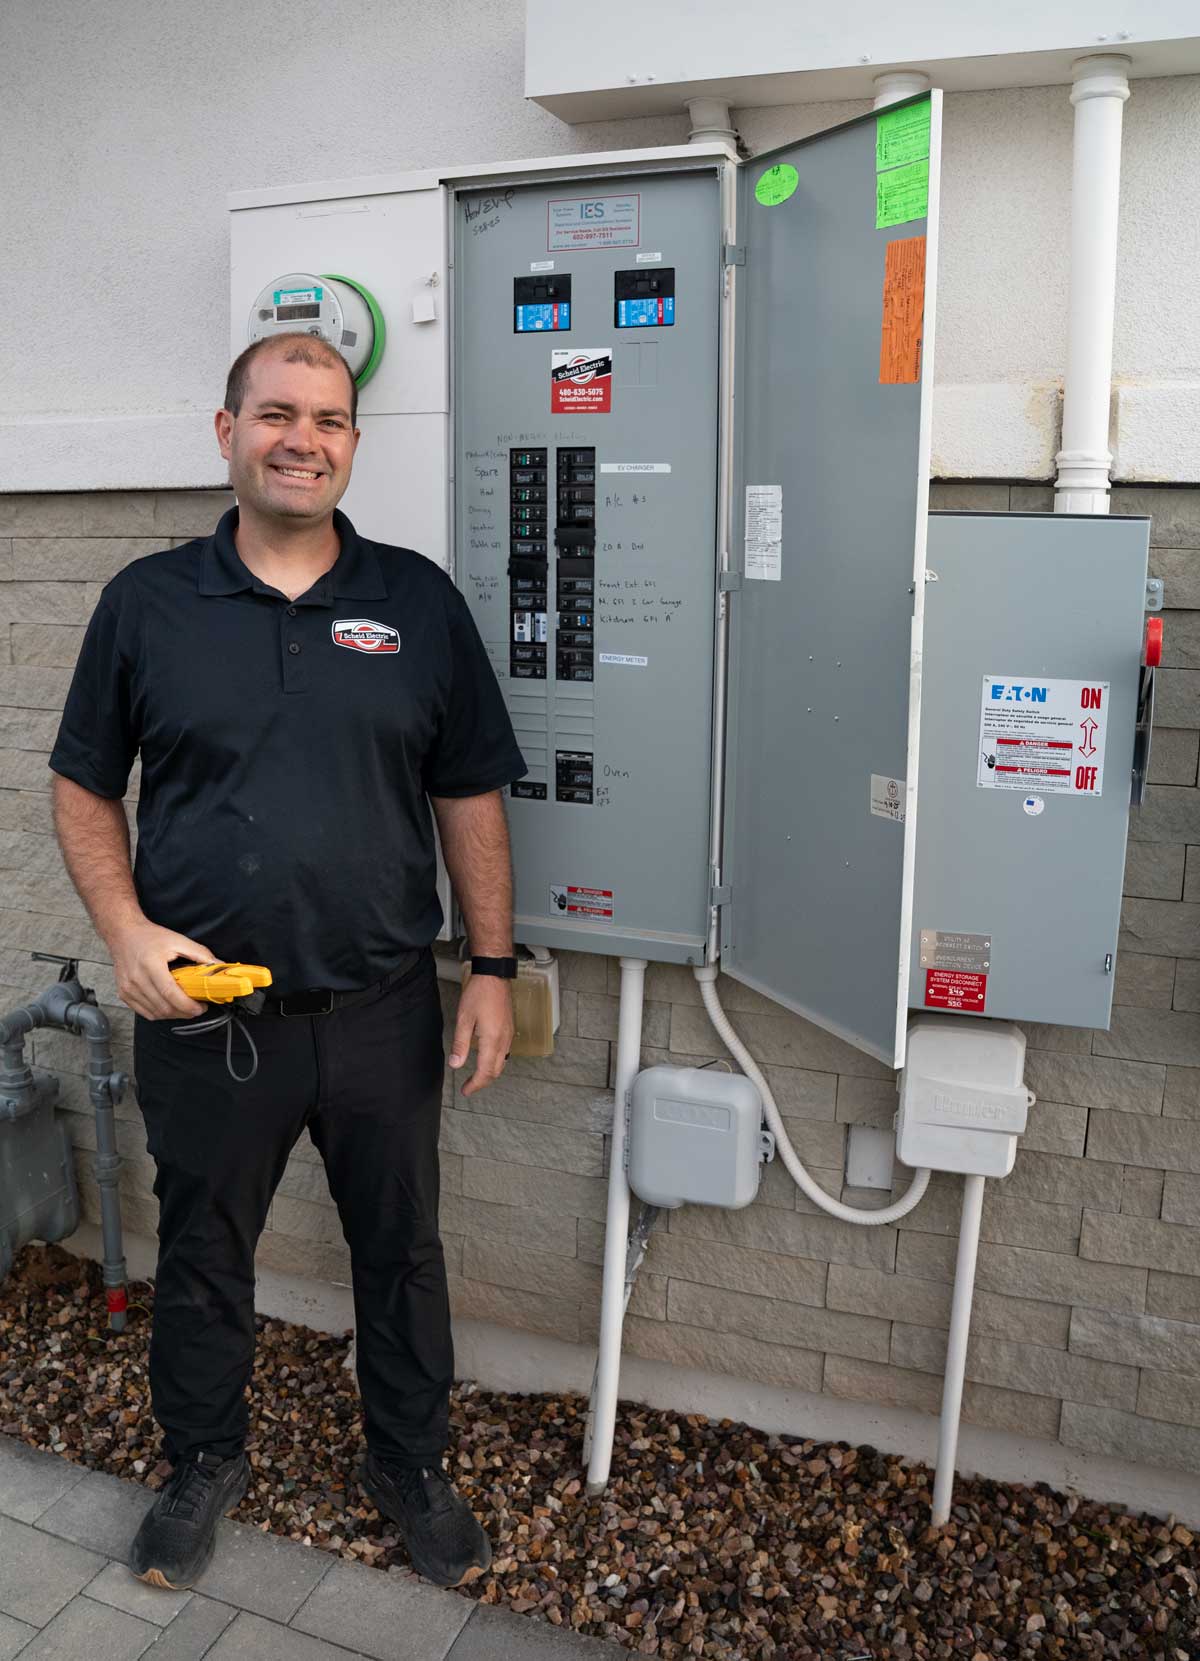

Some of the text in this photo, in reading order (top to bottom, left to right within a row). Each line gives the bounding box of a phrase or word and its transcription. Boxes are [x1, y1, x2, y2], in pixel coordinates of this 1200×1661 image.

[580, 202, 604, 219] IES
[557, 360, 605, 379] Scheid Electric
[343, 632, 389, 640] Scheid Electric
[991, 684, 1047, 703] EATON
[1080, 687, 1102, 709] ON
[603, 764, 630, 778] Oven
[1075, 766, 1098, 790] OFF
[950, 978, 982, 987] DISCONNECT
[955, 973, 979, 981] STORAGE
